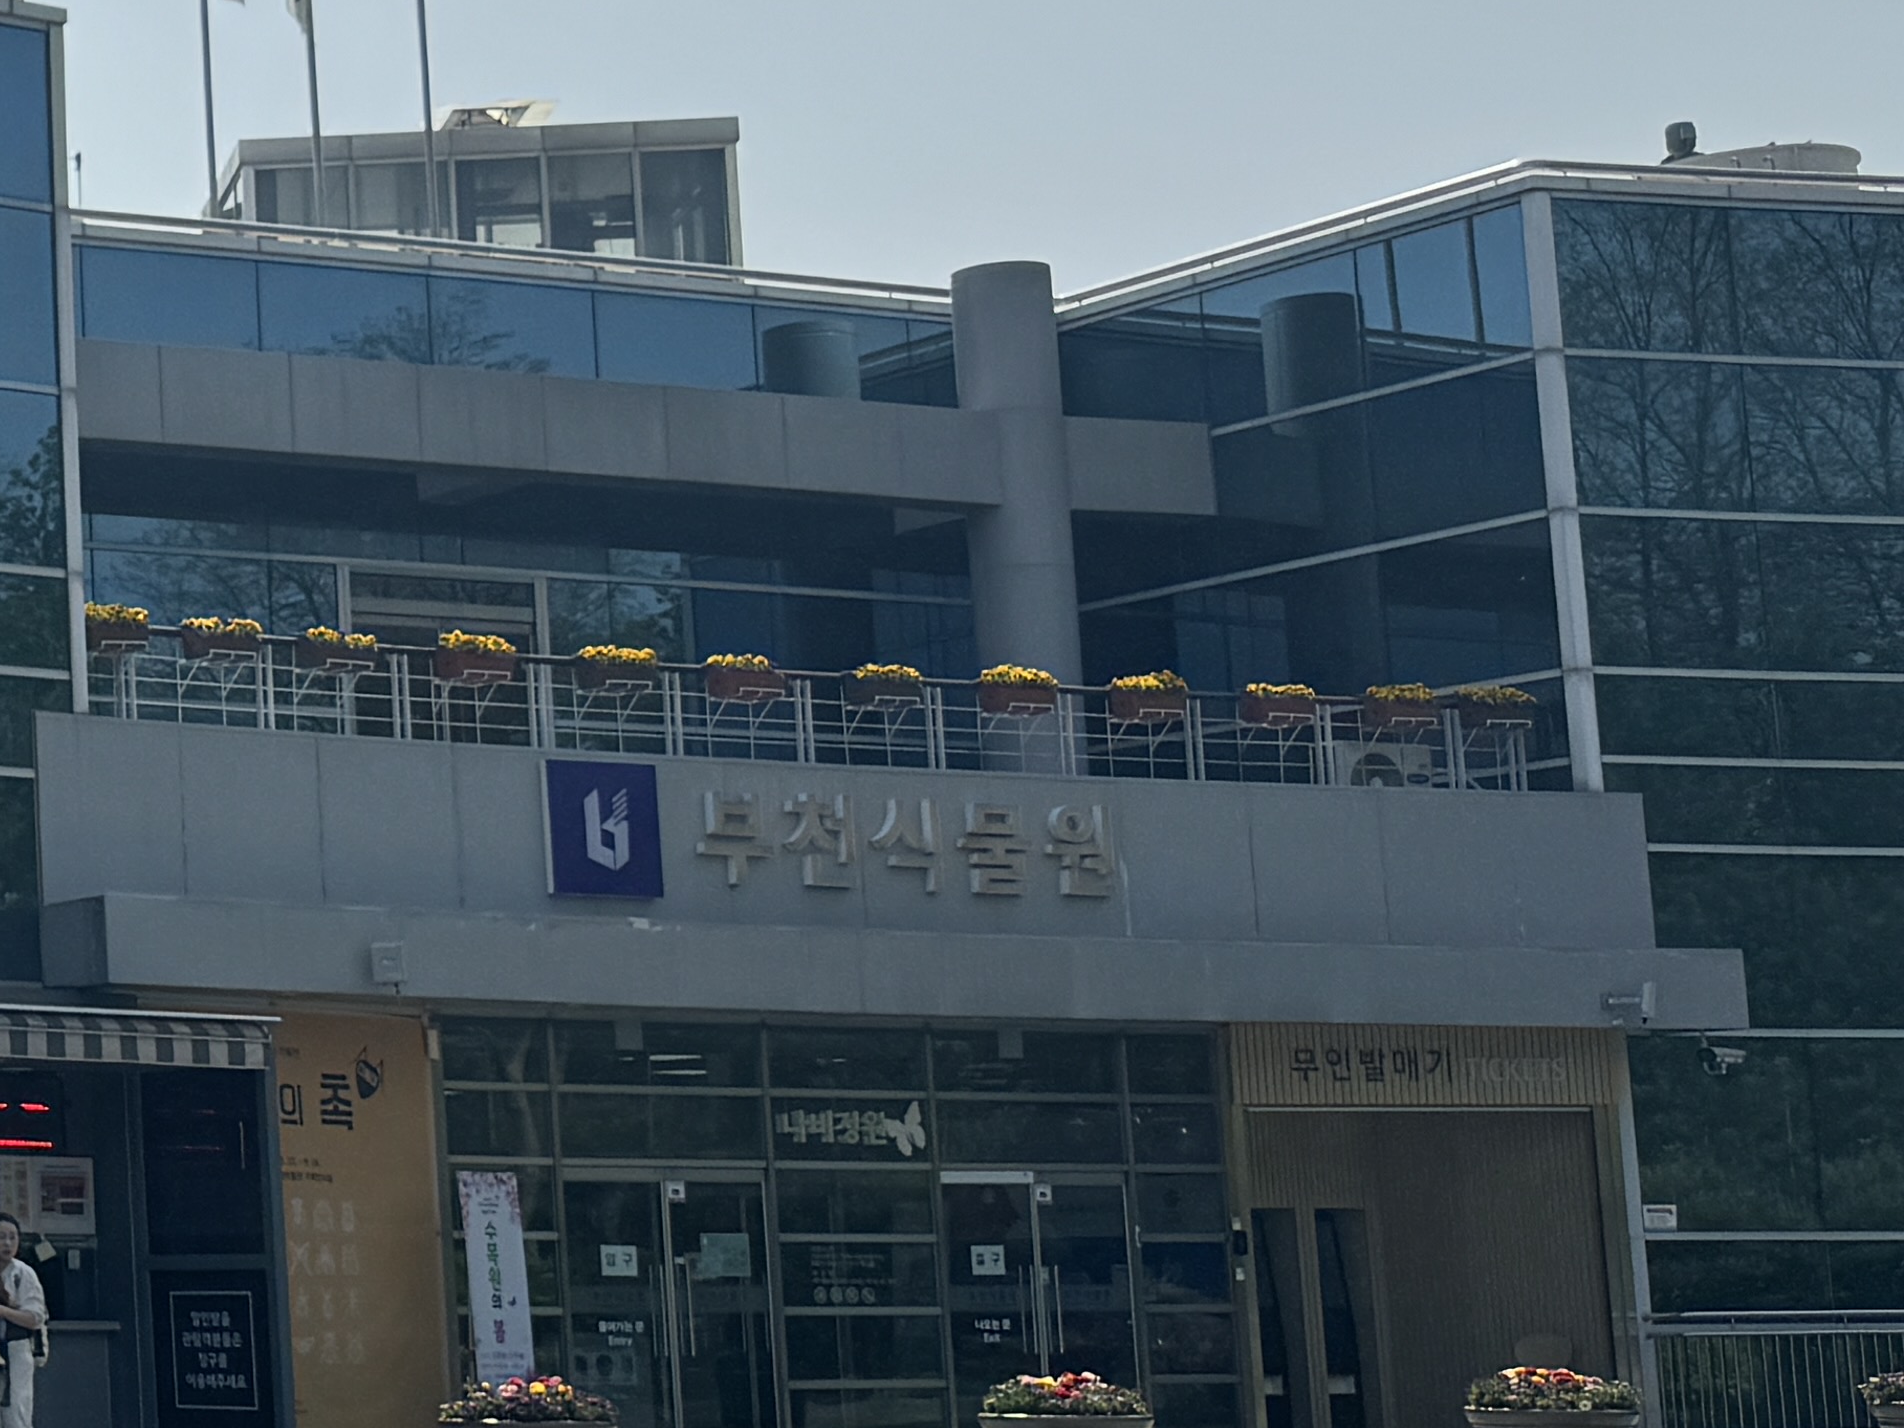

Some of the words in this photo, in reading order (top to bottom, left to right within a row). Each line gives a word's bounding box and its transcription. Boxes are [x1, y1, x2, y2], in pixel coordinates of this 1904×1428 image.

[696, 790, 1118, 898] 부천식물원
[1291, 1046, 1453, 1084] 무인발매기
[775, 1109, 889, 1146] 나비정원
